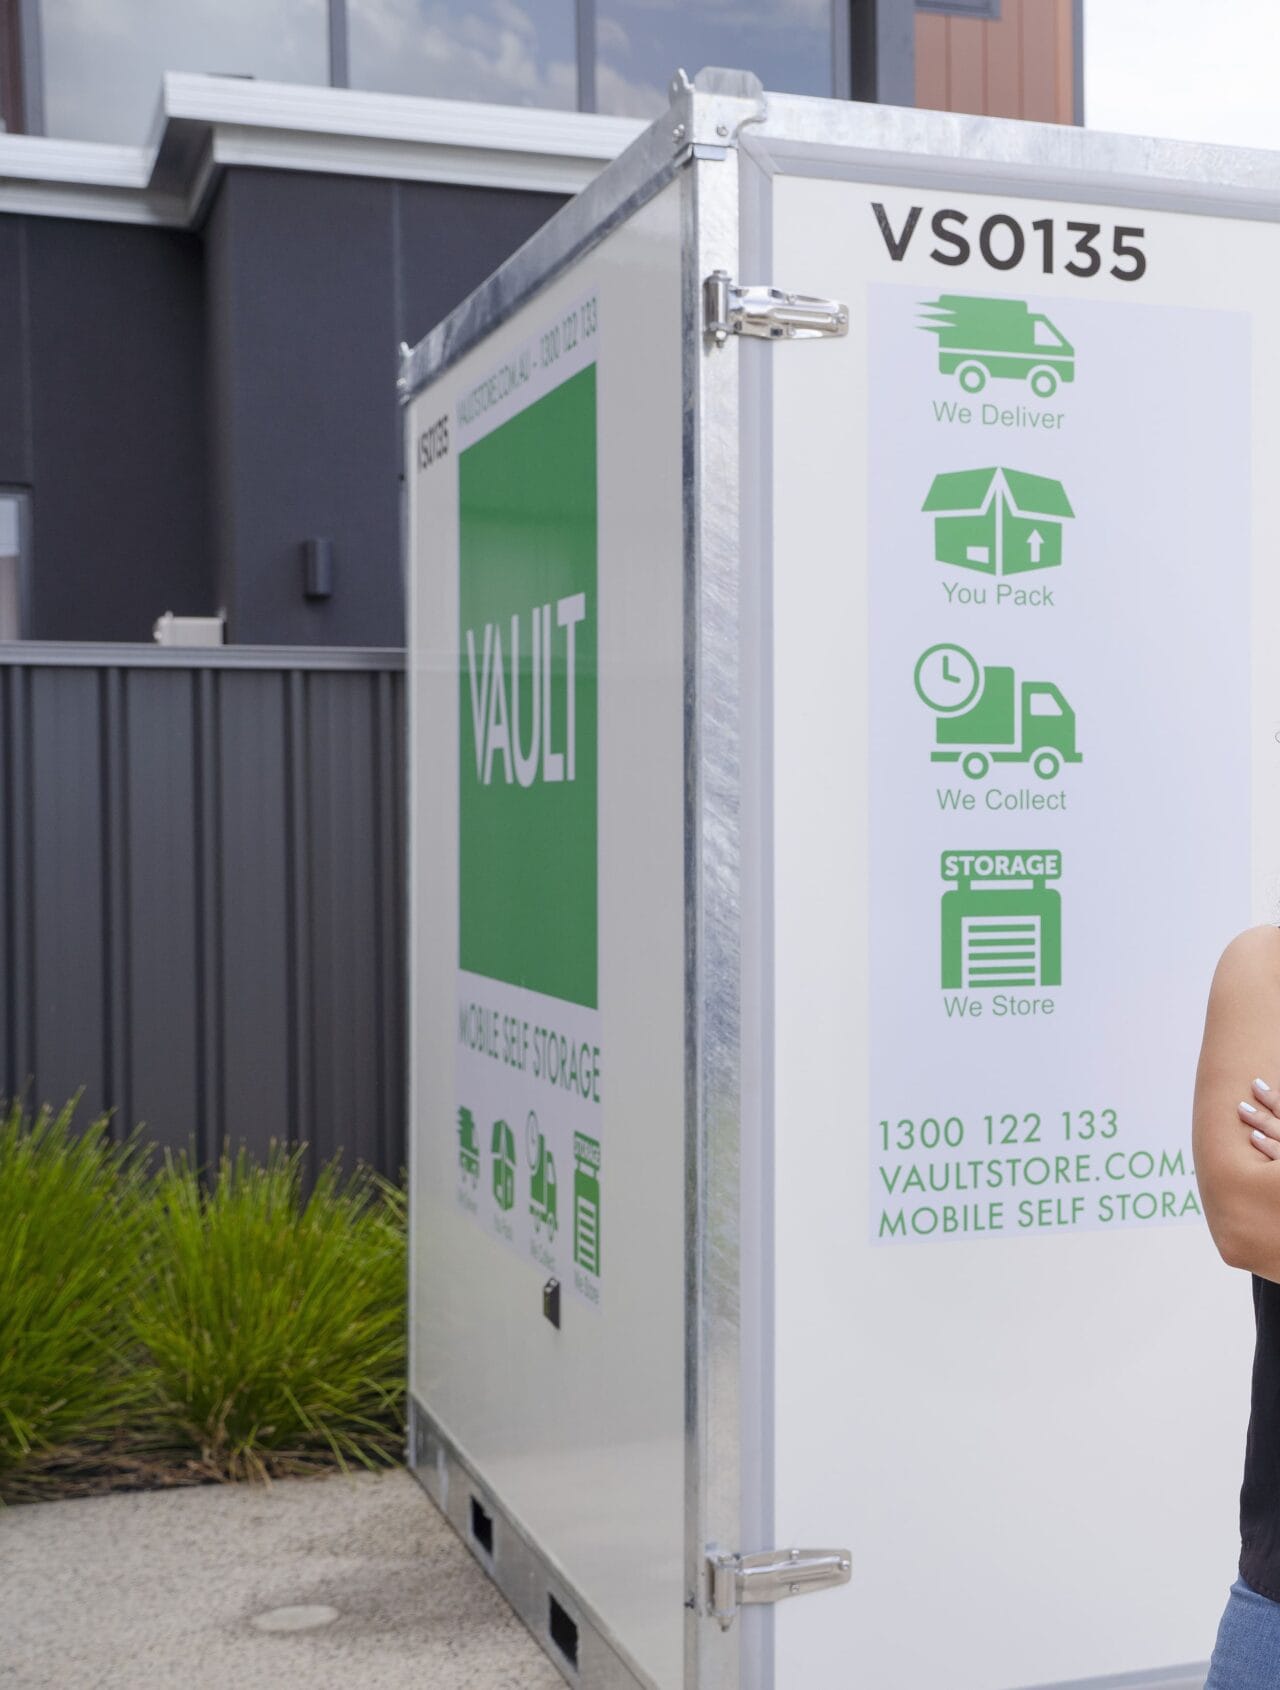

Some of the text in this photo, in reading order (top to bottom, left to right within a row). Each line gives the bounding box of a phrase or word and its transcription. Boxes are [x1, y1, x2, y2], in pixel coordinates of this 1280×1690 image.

[933, 400, 1065, 430] We Deliver
[942, 581, 1055, 607] You Pack
[465, 592, 586, 788] VAULT
[936, 788, 1067, 811] We Collect
[944, 854, 1059, 877] STORAGE
[943, 994, 1055, 1018] We Store
[458, 1002, 601, 1104] MOBILE SELF STORAGE
[879, 1108, 1118, 1151] 1300 122 133
[878, 1148, 1195, 1196] VAULTSTORE.COM.
[878, 1188, 1201, 1238] MOBILE SELF STORA
